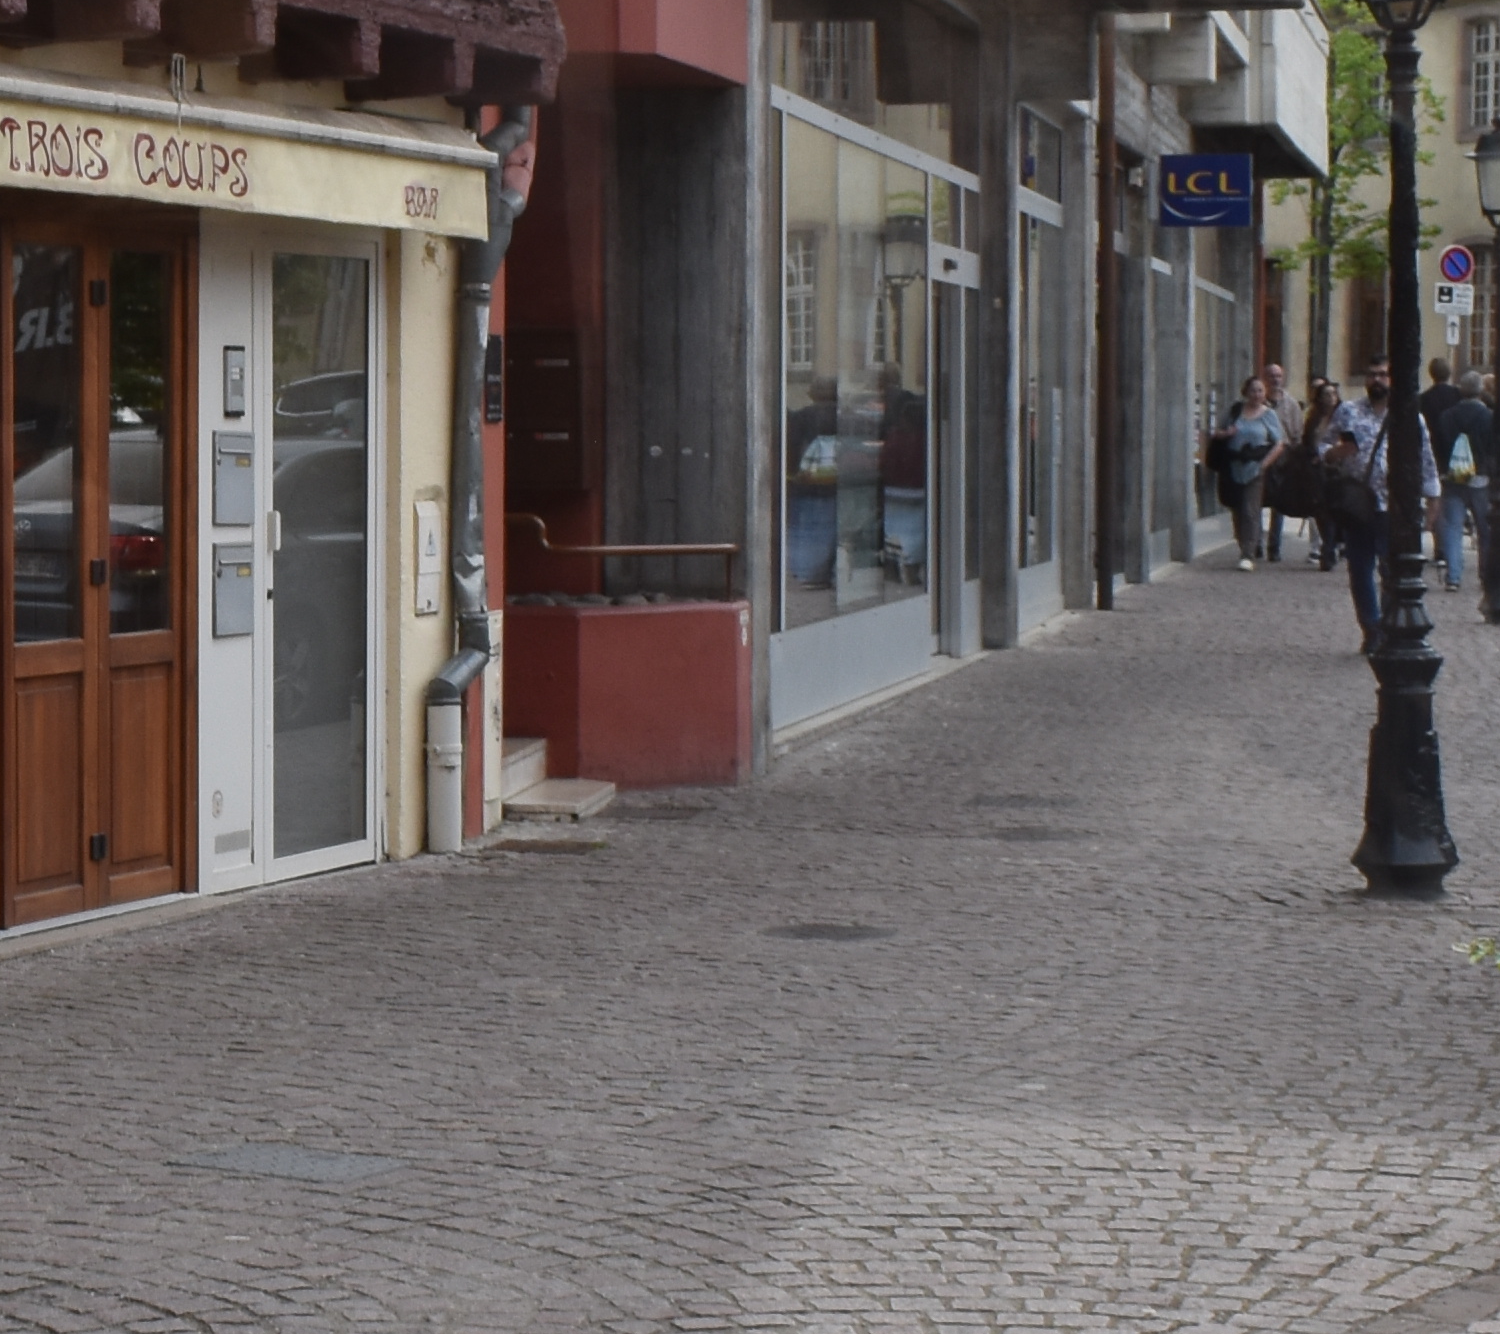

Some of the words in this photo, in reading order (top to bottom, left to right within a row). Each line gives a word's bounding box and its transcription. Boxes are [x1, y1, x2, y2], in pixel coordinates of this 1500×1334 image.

[0, 117, 109, 180] TROIS
[134, 132, 249, 197] COUPS
[1168, 170, 1241, 195] LCL
[404, 185, 439, 220] BAR
